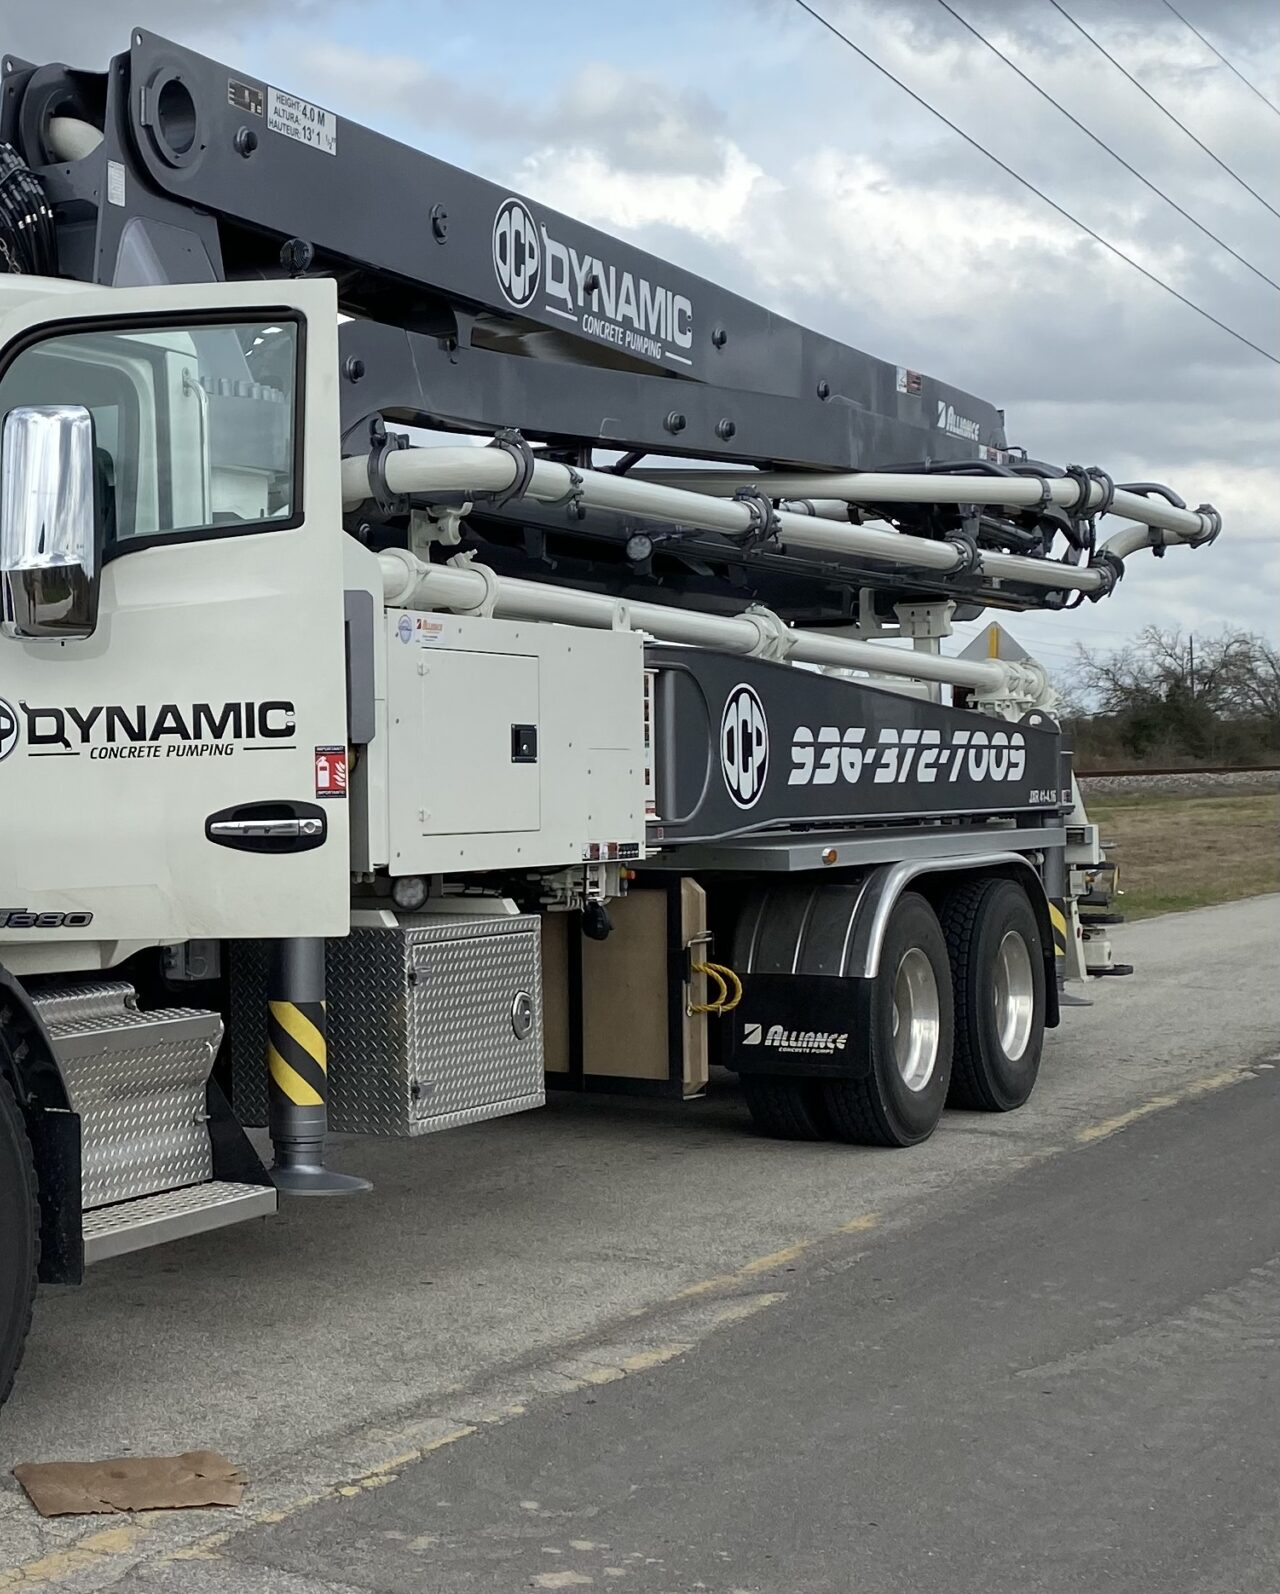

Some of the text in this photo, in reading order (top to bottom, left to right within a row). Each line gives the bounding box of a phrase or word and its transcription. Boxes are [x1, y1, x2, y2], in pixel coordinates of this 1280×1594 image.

[276, 93, 301, 112] HEIGHT:
[273, 106, 301, 125] ALTURA:
[302, 104, 326, 127] 4.0 M
[269, 118, 300, 139] HAUTEUR:
[540, 221, 693, 349] DYNAMIC
[582, 313, 662, 360] CONCRETE PUMPING
[18, 700, 297, 751] DYNAMIC
[90, 743, 234, 760] CONCRETE PUMPING
[788, 726, 1027, 785] 936-372-7009
[764, 1024, 849, 1050] ALLIANCE
